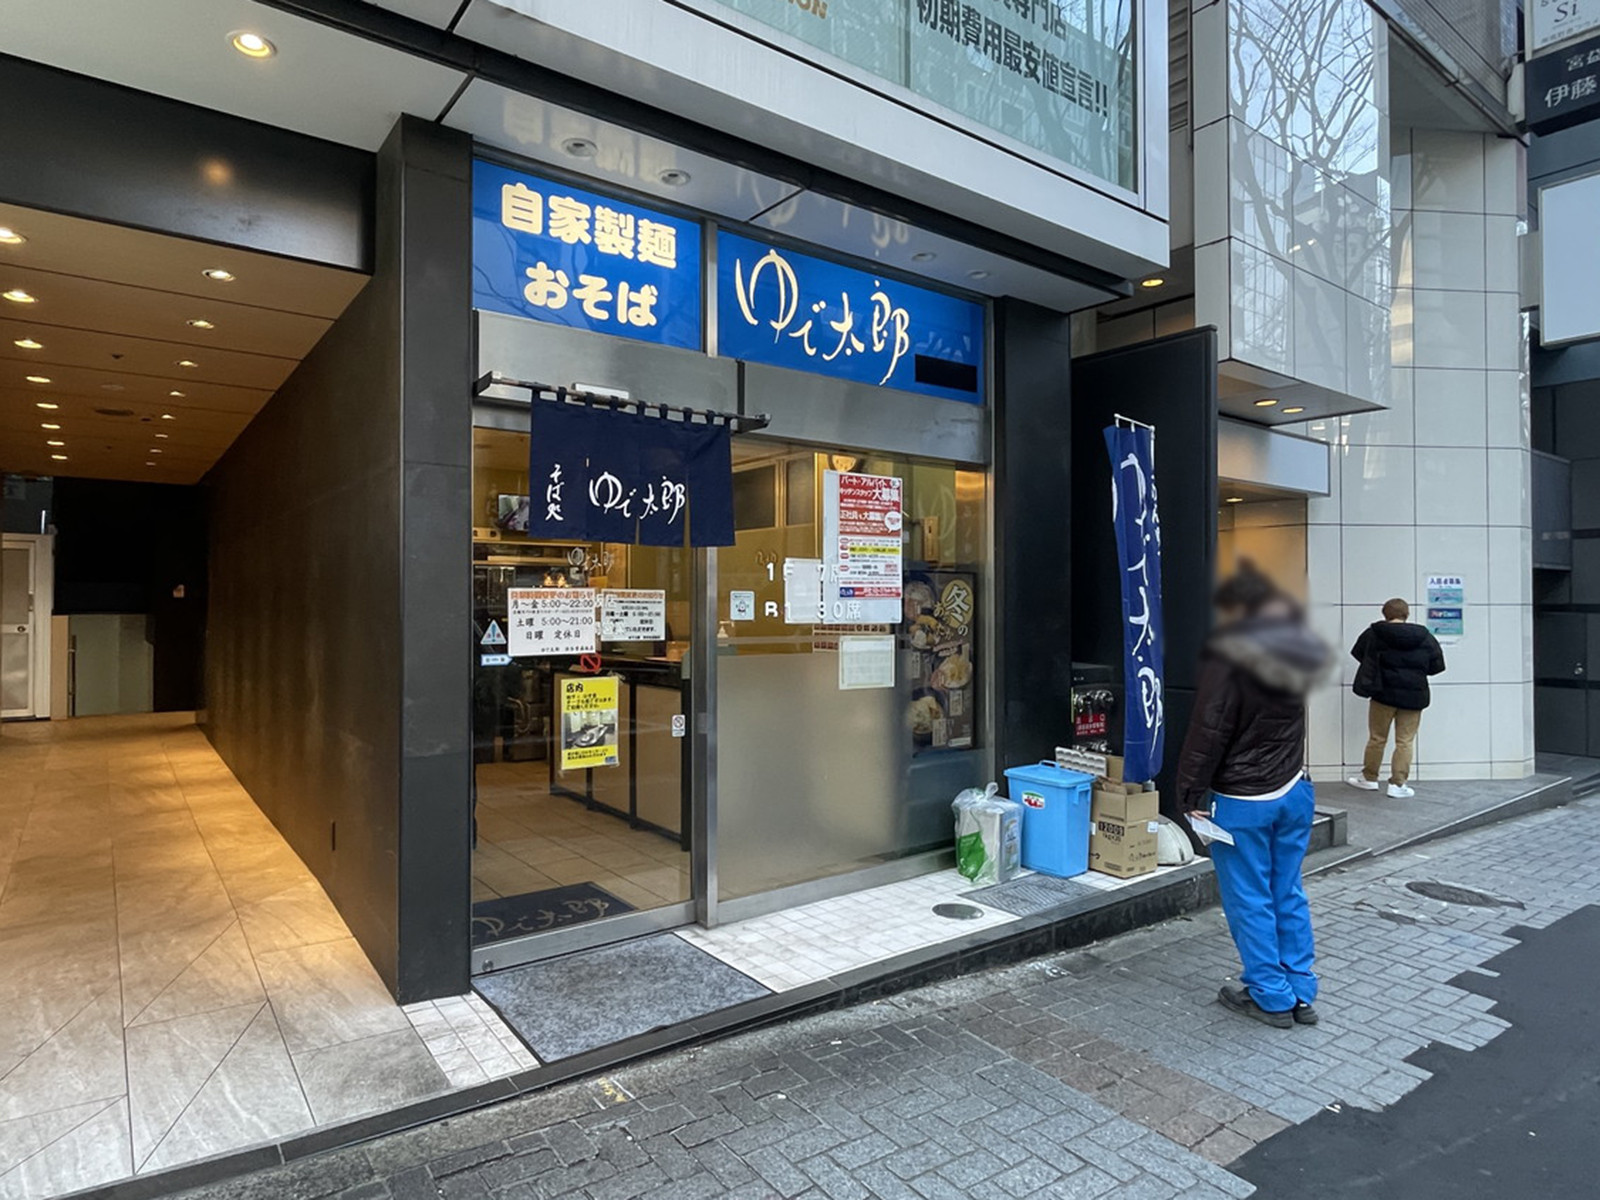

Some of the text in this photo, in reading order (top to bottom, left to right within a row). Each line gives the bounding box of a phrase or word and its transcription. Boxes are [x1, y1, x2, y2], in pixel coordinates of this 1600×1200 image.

[500, 182, 678, 270] 自家製麺
[523, 261, 658, 328] おそば
[735, 248, 911, 386] ゆで太郎
[588, 470, 686, 525] ゆで太郎
